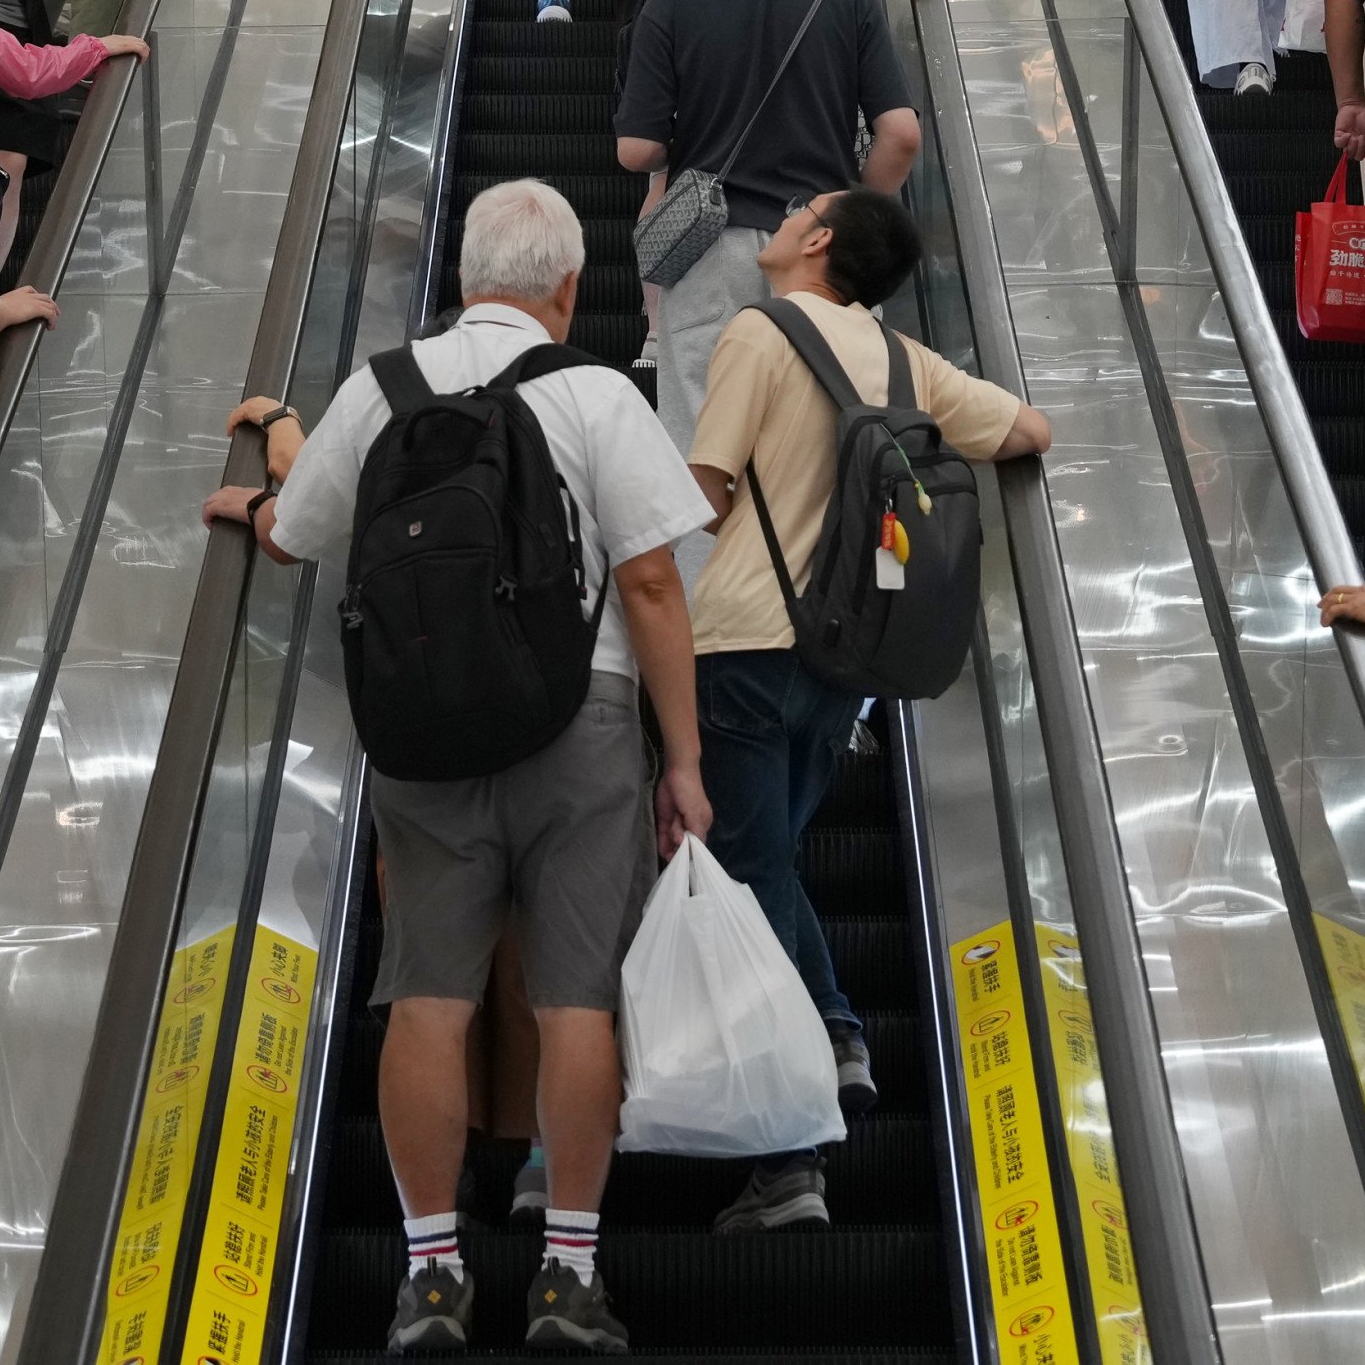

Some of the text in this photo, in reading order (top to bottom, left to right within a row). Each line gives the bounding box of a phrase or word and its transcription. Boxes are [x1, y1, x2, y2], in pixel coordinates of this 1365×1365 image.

[235, 1105, 266, 1205] 请照顾老人与小孩的安全
[996, 1084, 1024, 1184] 请照顾老人与小孩的安全
